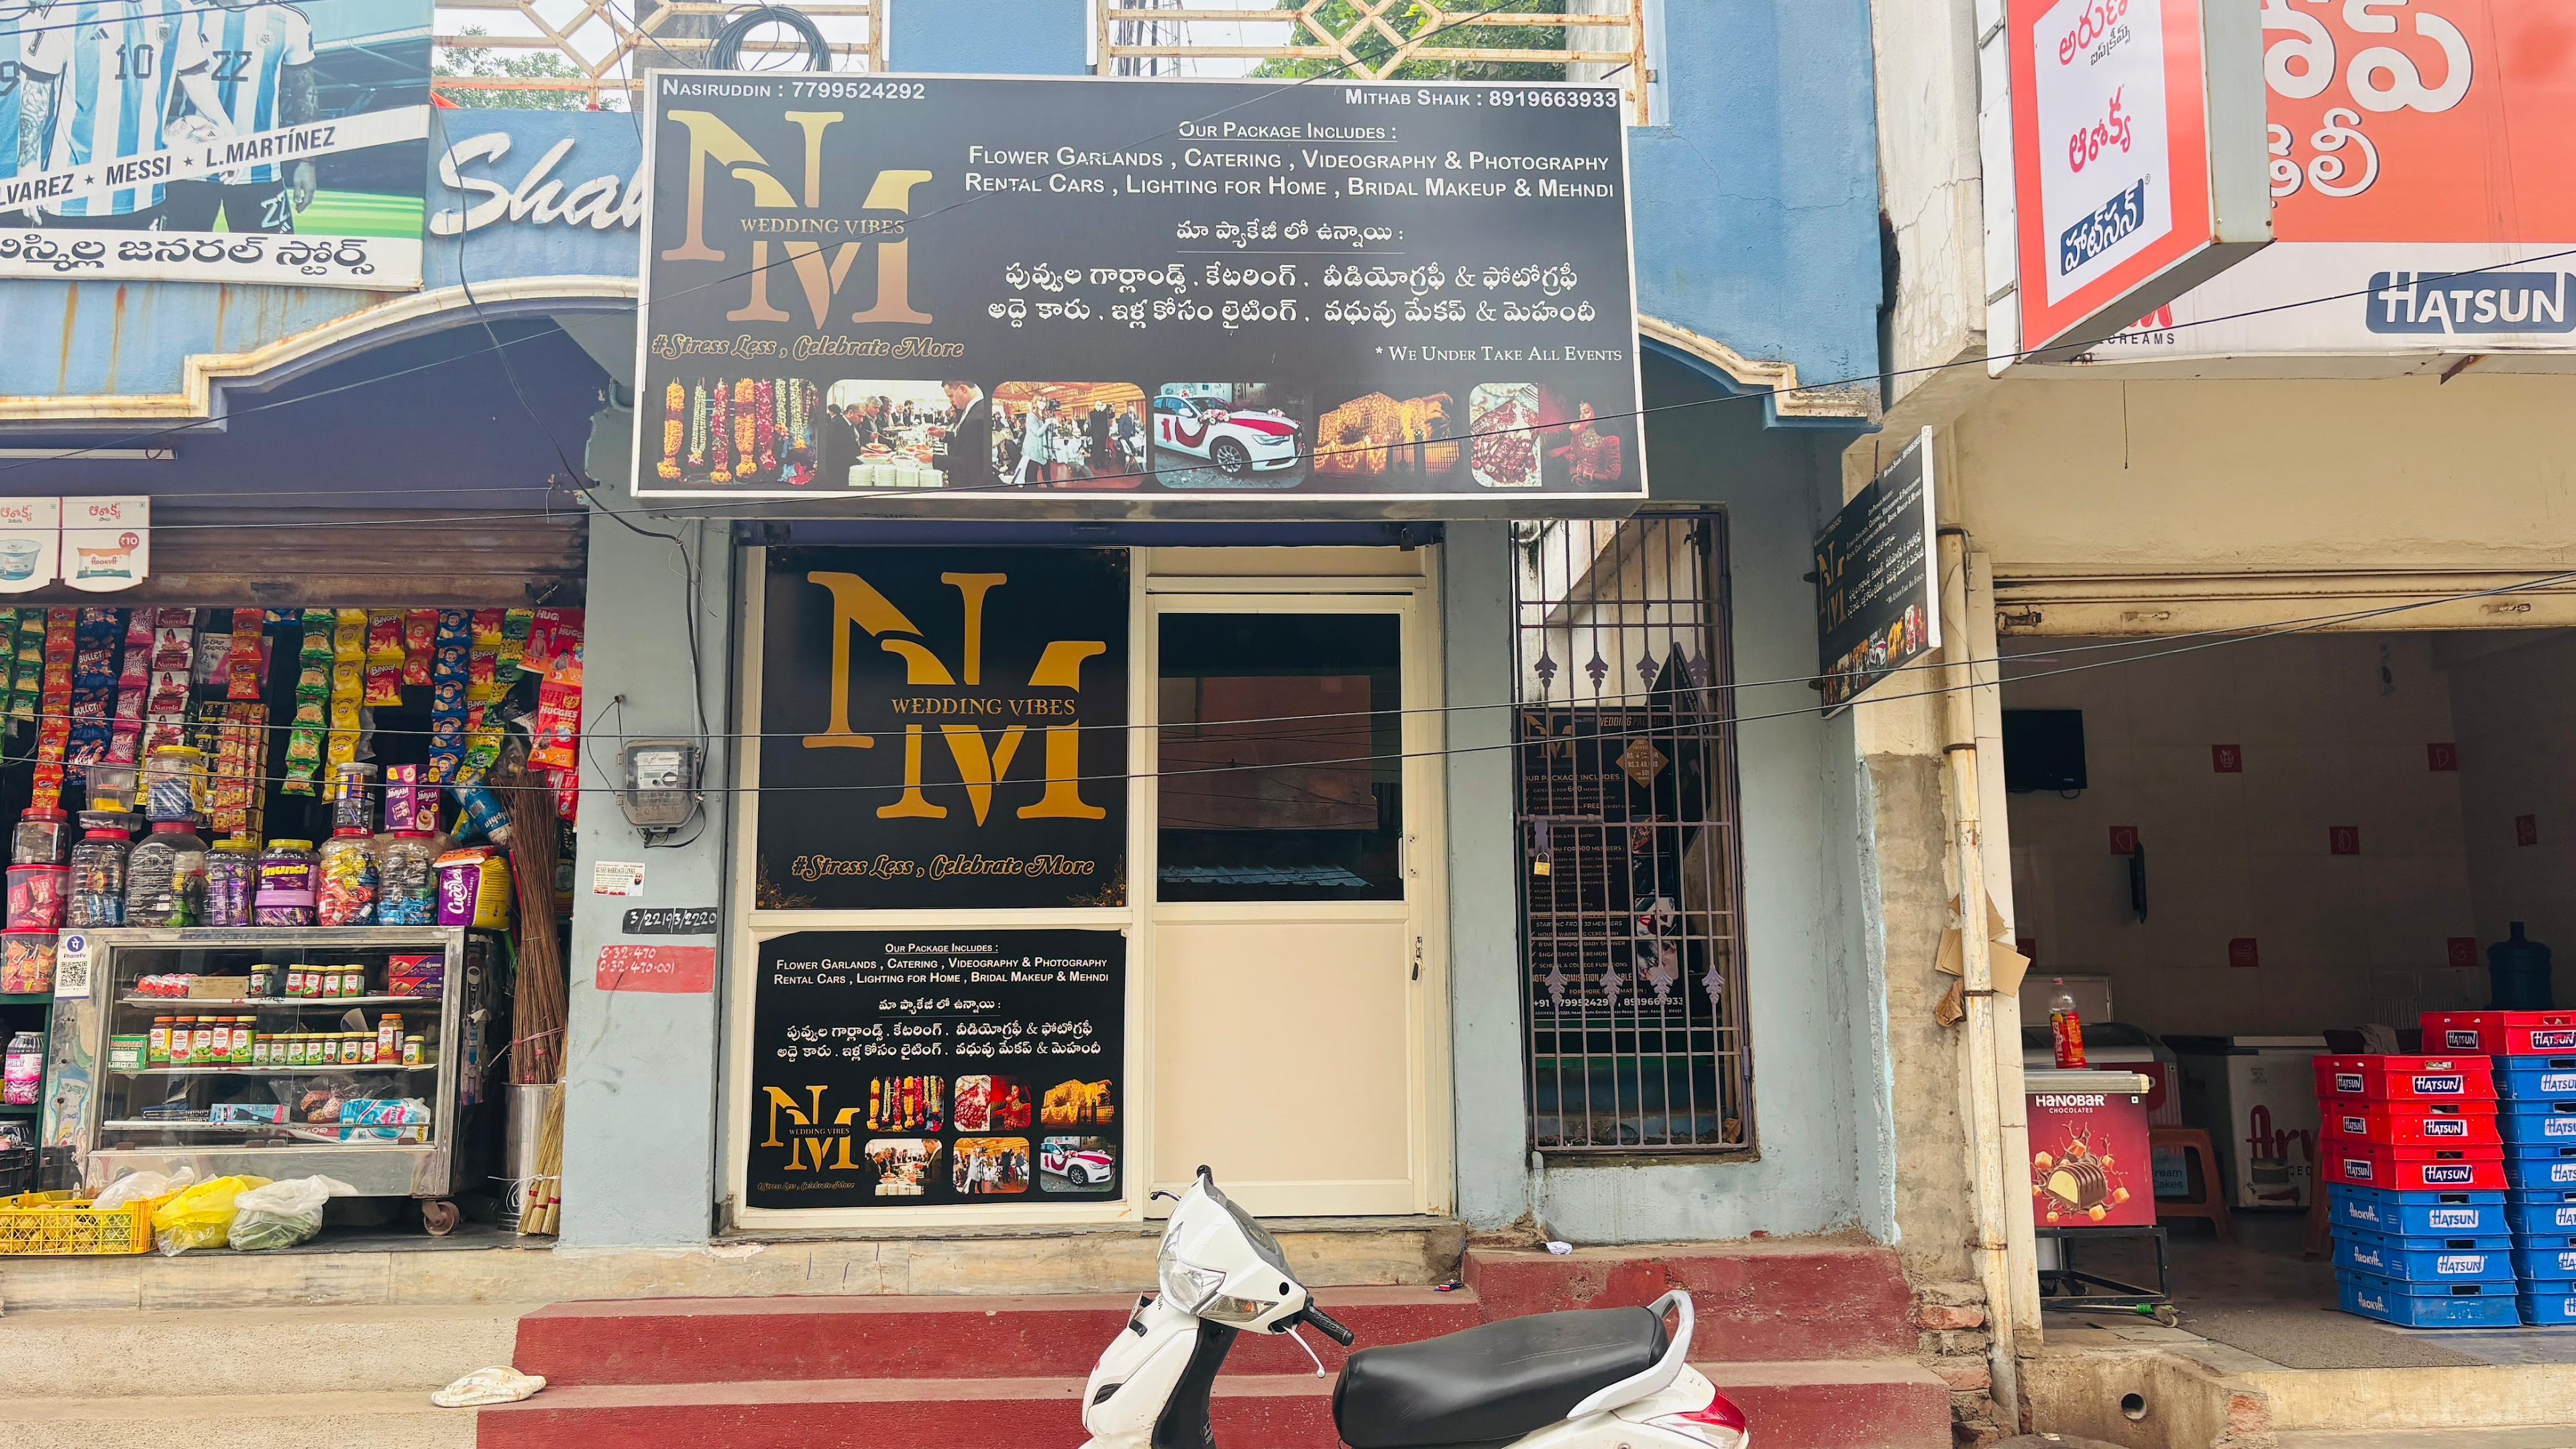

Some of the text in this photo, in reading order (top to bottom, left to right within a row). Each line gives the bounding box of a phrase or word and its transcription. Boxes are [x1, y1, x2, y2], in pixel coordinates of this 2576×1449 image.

[115, 44, 154, 80] 10
[211, 50, 252, 82] 22
[792, 82, 924, 99] 7799524292
[1489, 91, 1617, 107] 8919663933
[106, 156, 171, 186] MESSI
[741, 218, 906, 235] WEDDING VIBES
[1177, 218, 1392, 248] మా ప్యాకేజీ లో ఉన్నాయి
[118, 237, 268, 264] జనరల్
[1006, 262, 1081, 292] పువ్వుల
[1206, 261, 1295, 286] కేటరింగ్
[1324, 262, 1445, 296] వీడియోగ్రఫీ
[1483, 262, 1576, 296] ఫోటోగ్రఫీ
[2377, 271, 2565, 334] HATSUN
[988, 299, 1026, 327] అద్దె
[1036, 299, 1090, 319] కారు
[1154, 297, 1213, 321] కోసం
[1222, 300, 1296, 329] లైటింగ్
[1325, 301, 1396, 328] వధువు
[1405, 297, 1466, 321] మేకప్
[1503, 301, 1595, 321] మెహందీ
[652, 333, 965, 361] #Stress Less Celebrate More
[2099, 333, 2175, 344] CREAMS
[540, 706, 578, 718] HUGGIES
[891, 698, 1076, 716] WEDDING VIBES
[1599, 716, 1632, 727] WEDDIG
[262, 864, 309, 877] munch
[792, 854, 1095, 881] #Stress Less Celebrate More
[879, 1000, 896, 1010] మా
[936, 998, 950, 1009] లో
[894, 1022, 942, 1036] కేటరింగ్
[802, 1044, 831, 1057] కారు
[865, 1043, 896, 1056] కోసం
[956, 1042, 995, 1058] వధువు
[999, 1040, 1032, 1054] మేకప్
[2338, 1074, 2361, 1091] HATSUN
[2416, 1077, 2461, 1092] HATSUN
[2425, 1120, 2461, 1136] HATSUN
[2426, 1166, 2471, 1181] HATSUN
[2432, 1210, 2475, 1227] HATSUN
[2439, 1256, 2483, 1273] HATSUN
